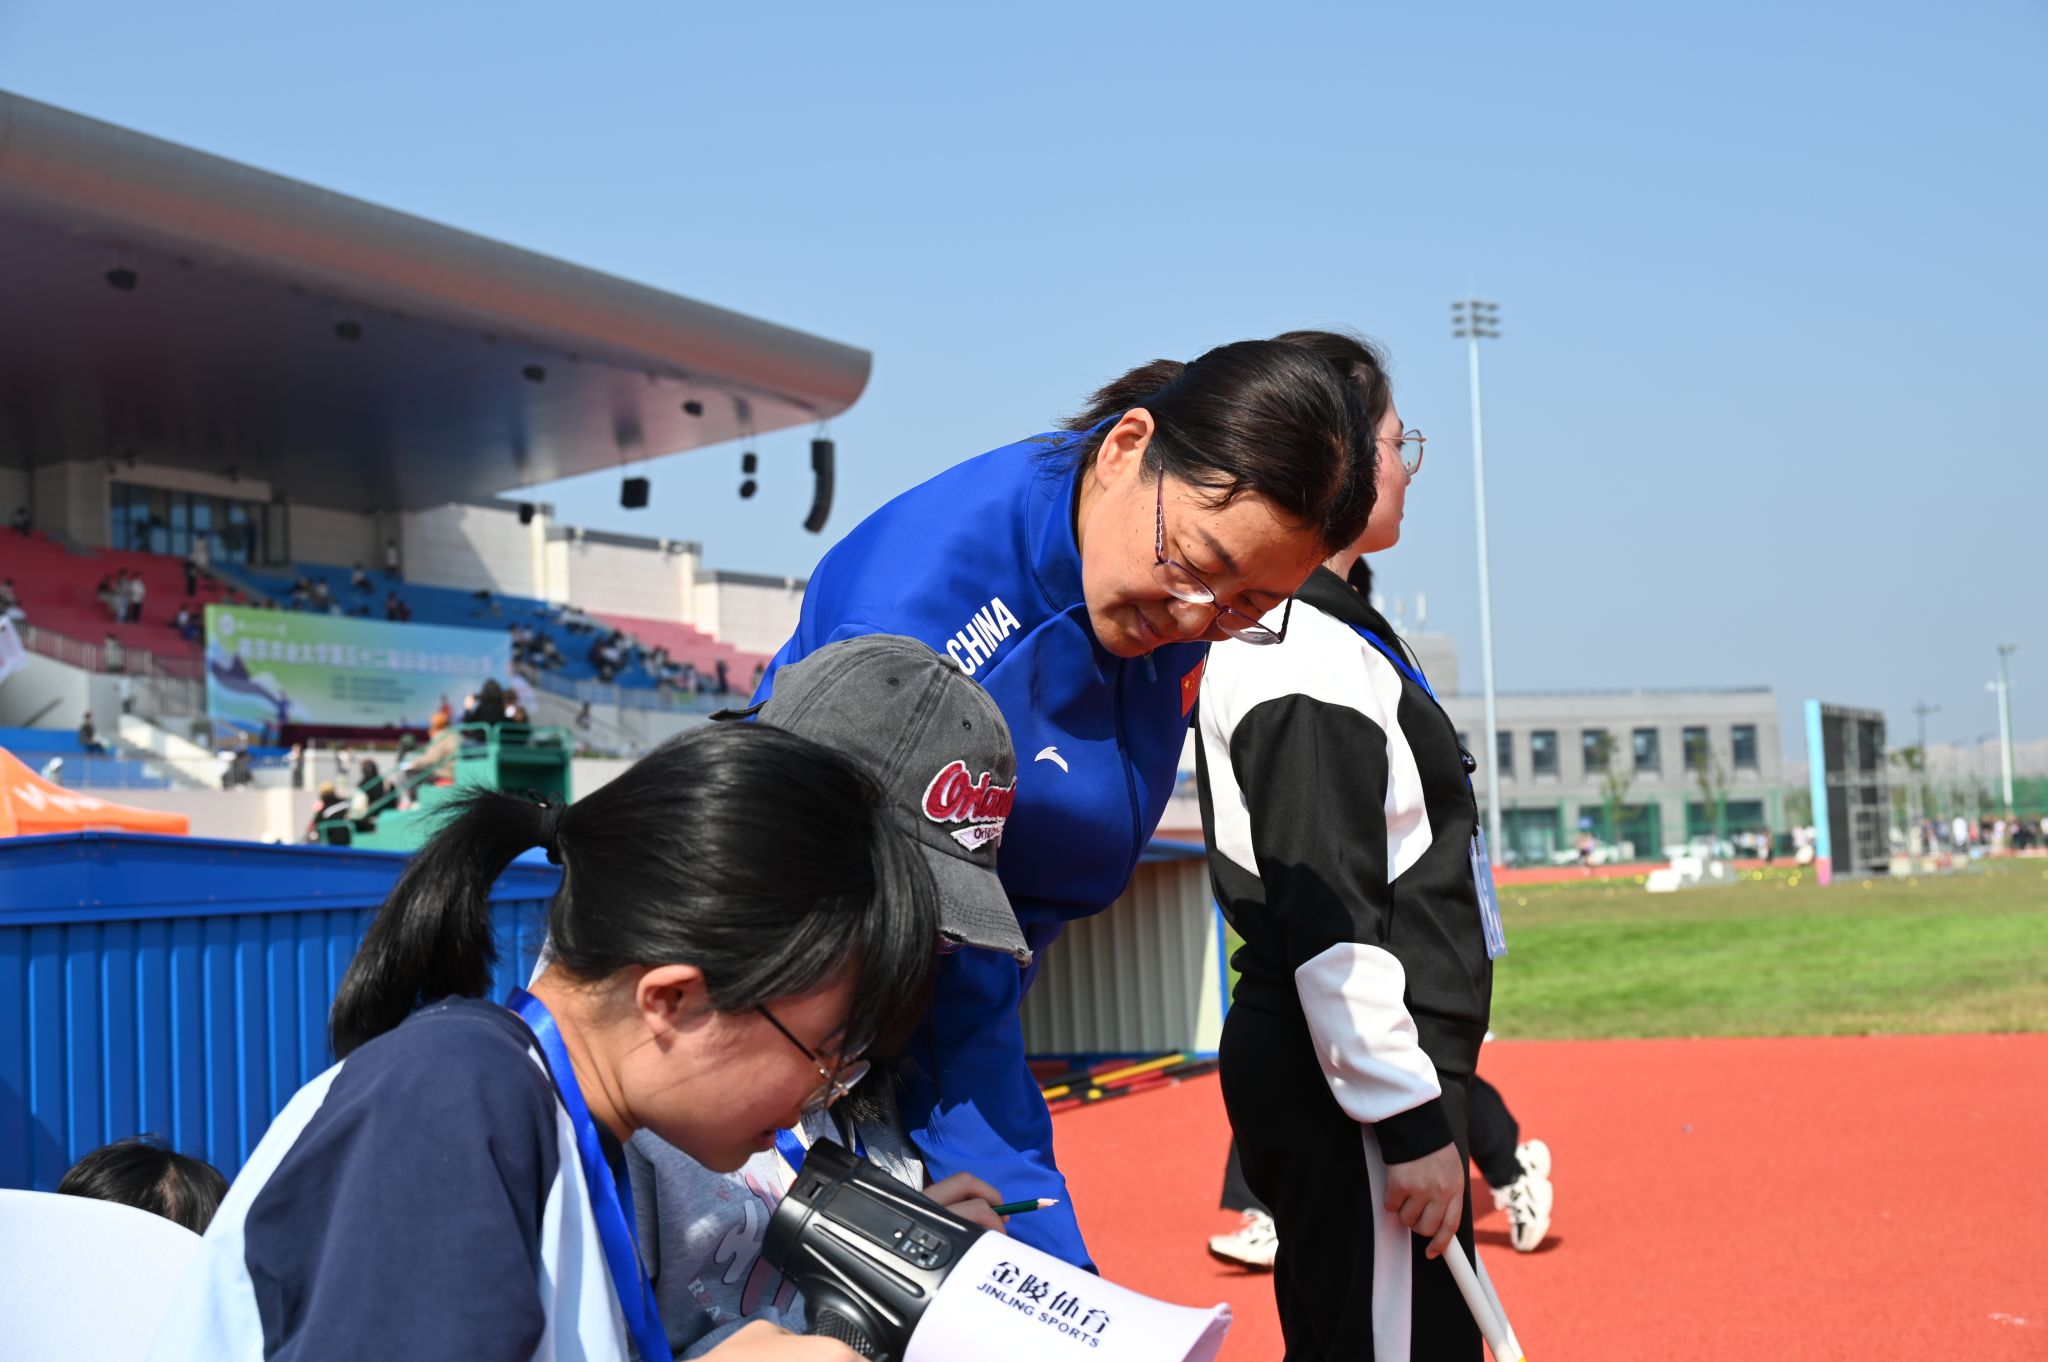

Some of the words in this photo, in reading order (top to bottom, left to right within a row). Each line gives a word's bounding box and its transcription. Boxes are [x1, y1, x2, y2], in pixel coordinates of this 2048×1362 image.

[946, 597, 1021, 676] CHINA
[977, 1283, 1035, 1316] JINLING
[1038, 1312, 1100, 1348] SPORTS
[987, 1262, 1110, 1333] 金陵体育
